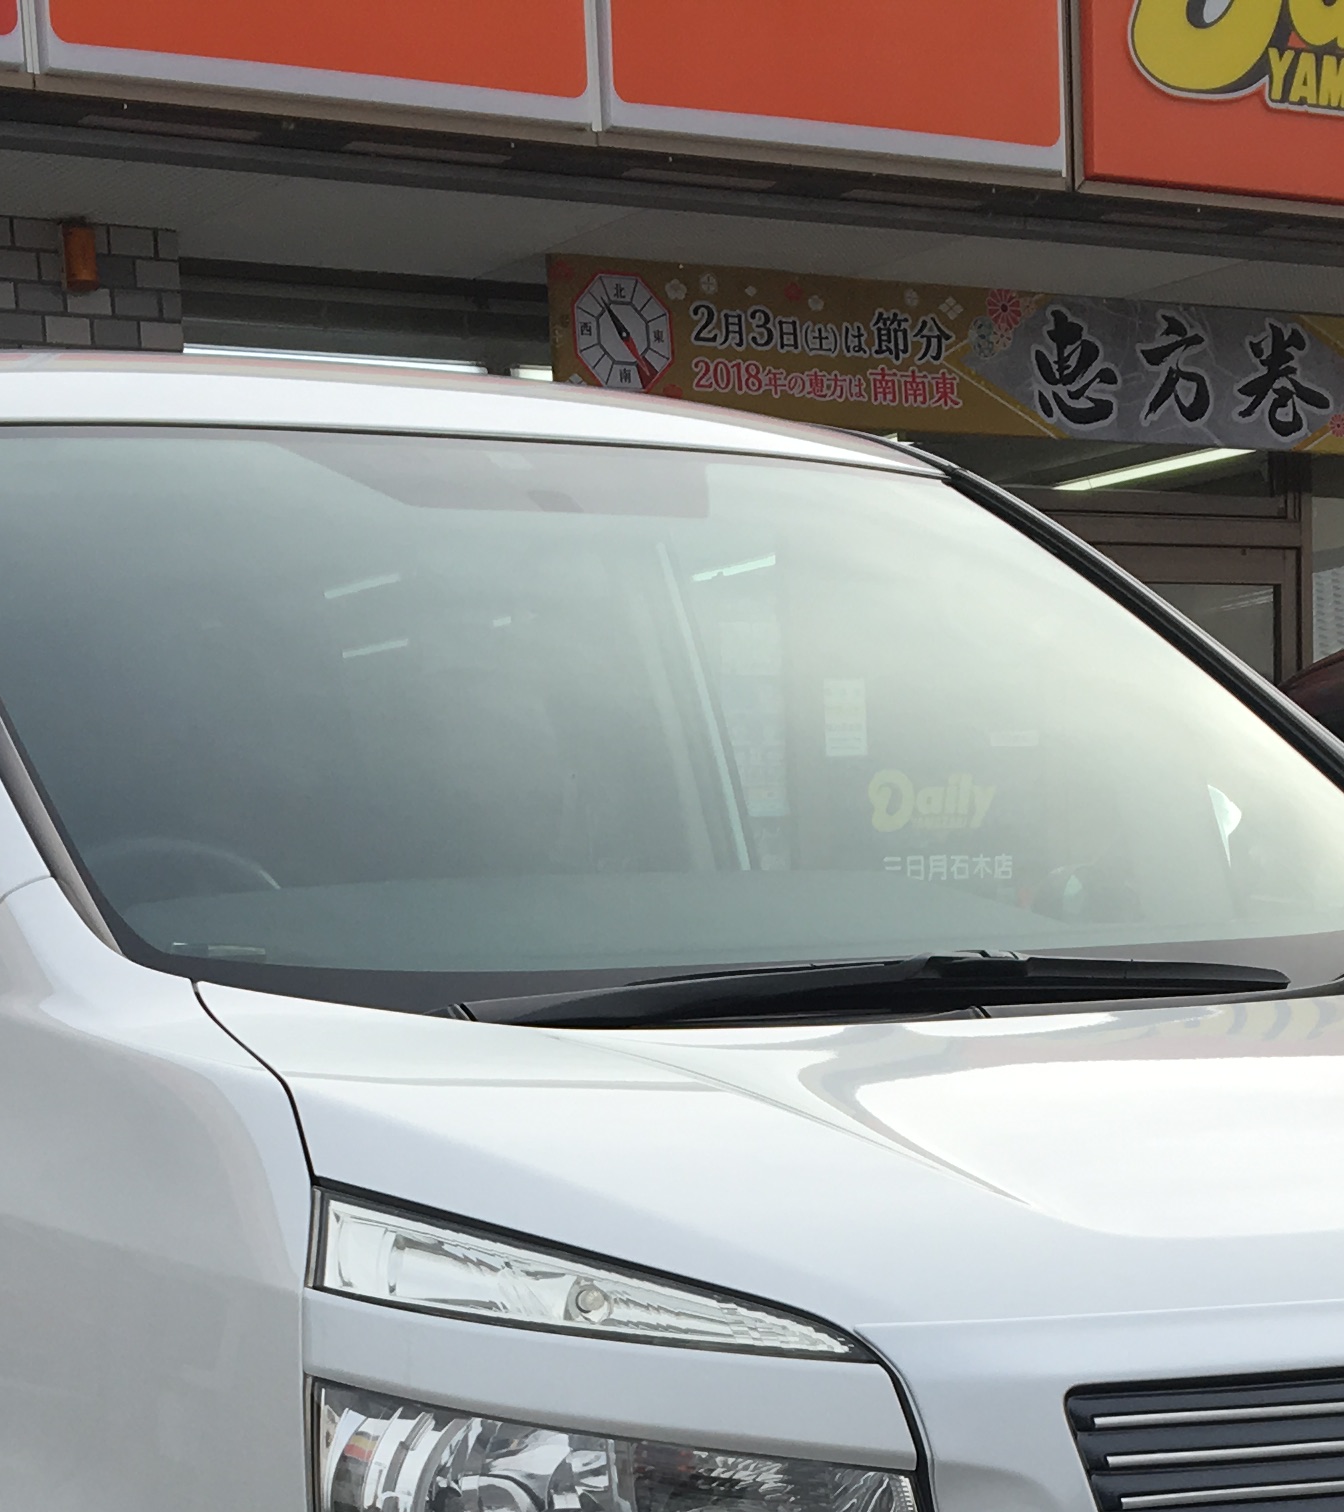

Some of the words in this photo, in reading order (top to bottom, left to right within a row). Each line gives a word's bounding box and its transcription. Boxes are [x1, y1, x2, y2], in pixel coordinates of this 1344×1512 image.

[612, 283, 626, 299] 北
[579, 320, 593, 336] 西
[618, 368, 632, 384] 南
[693, 360, 961, 408] 2018年の恵方は南南東
[1034, 308, 1333, 437] 恵方巻
[868, 769, 997, 832] Daily
